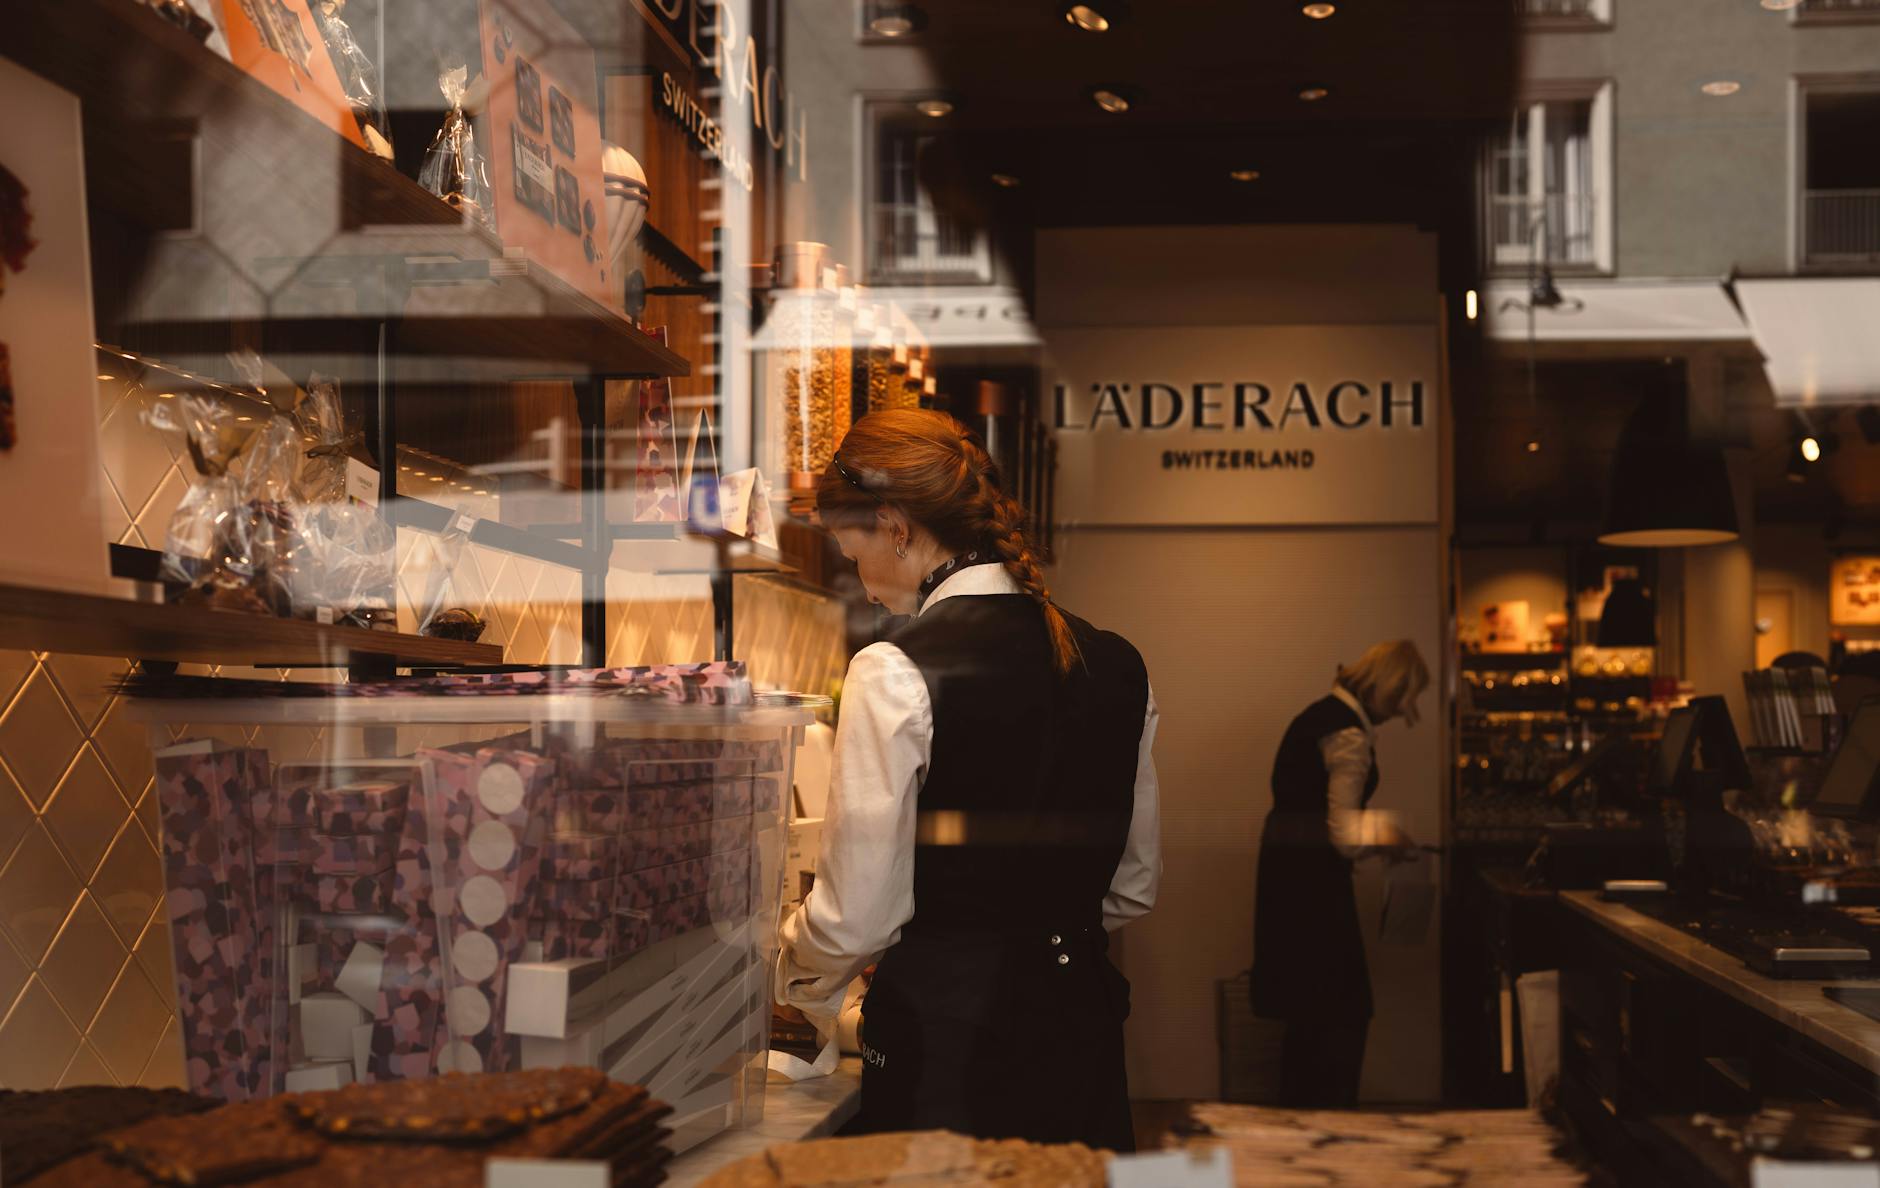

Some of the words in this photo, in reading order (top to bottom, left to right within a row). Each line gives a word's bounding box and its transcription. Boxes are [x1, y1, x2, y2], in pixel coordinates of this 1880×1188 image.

[654, 0, 807, 182] ERACH
[1054, 380, 1424, 430] LÄDERACH
[1161, 449, 1315, 470] SWITZERLAND
